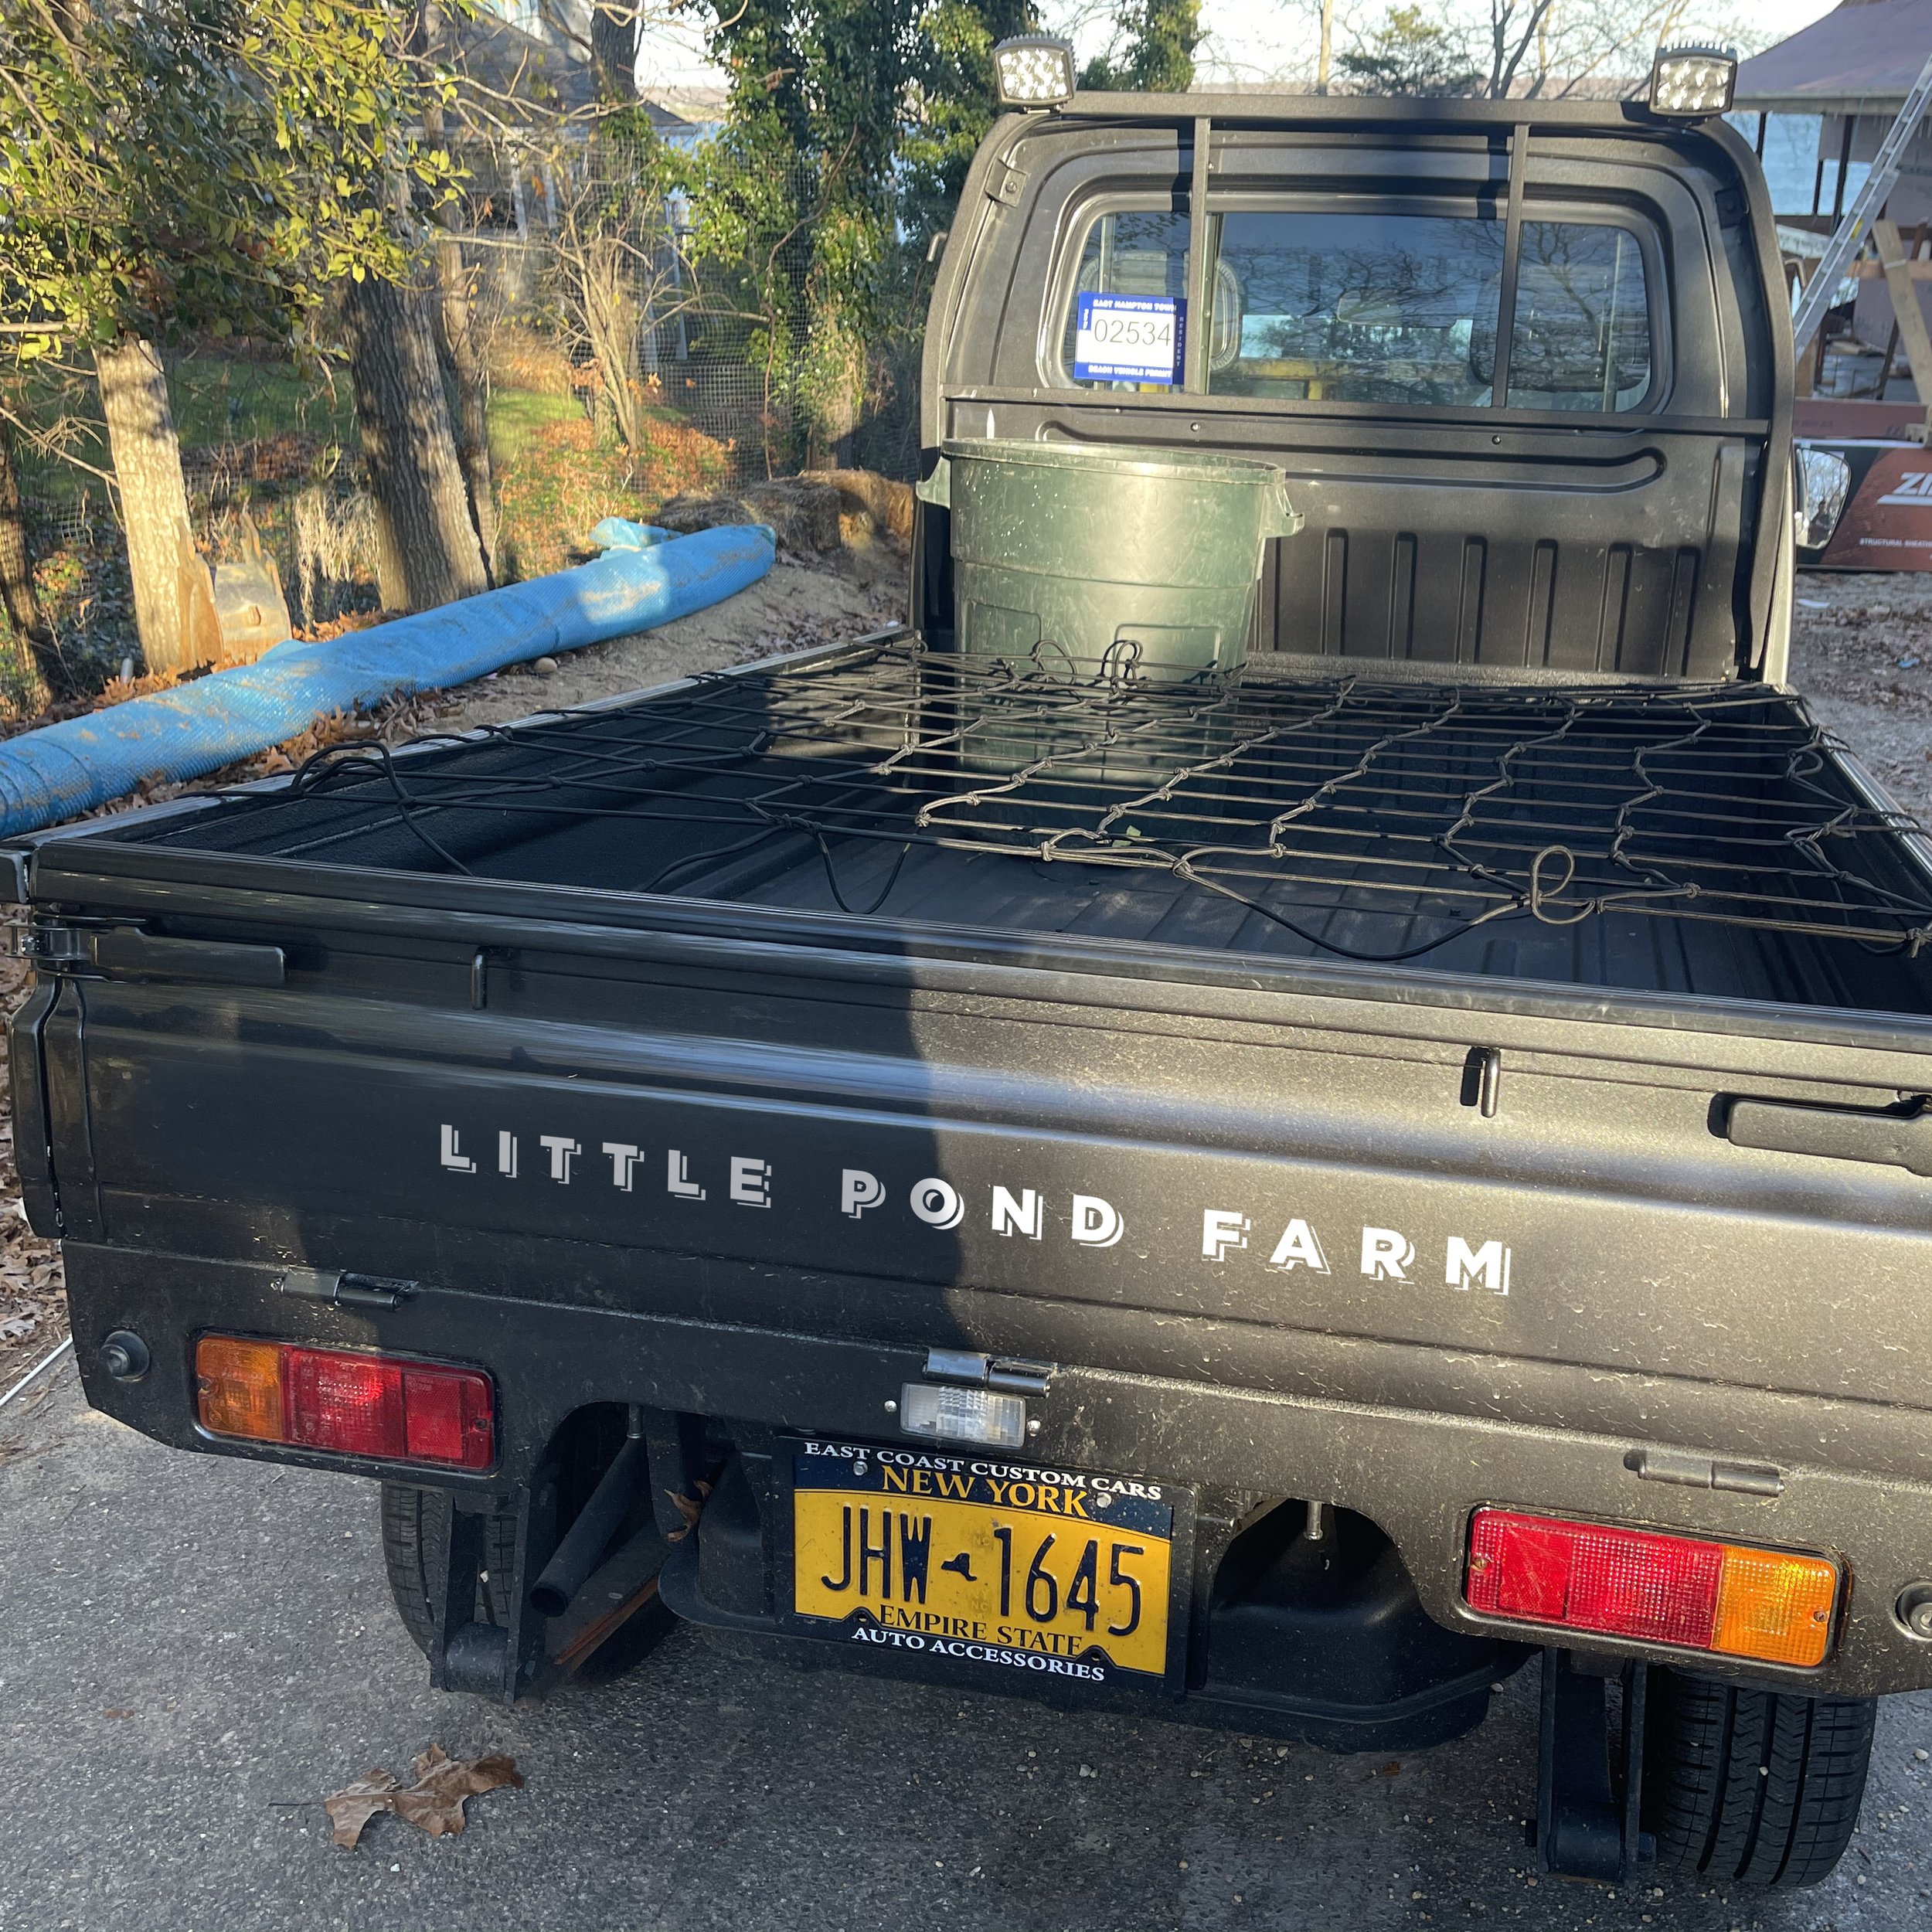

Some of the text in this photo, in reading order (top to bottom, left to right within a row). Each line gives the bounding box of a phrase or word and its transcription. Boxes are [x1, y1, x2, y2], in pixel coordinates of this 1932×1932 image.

[1093, 299, 1114, 308] EAST
[1114, 301, 1153, 311] HAMPTON
[1094, 318, 1172, 347] 02534
[1859, 538, 1903, 547] STRUCTURAL
[440, 1124, 1512, 1295] LITTLE POND FARM
[804, 1442, 1162, 1500] EAST COAST CUSTOM CARS
[882, 1465, 1089, 1518] NEW YORK
[851, 1627, 1106, 1682] AUTO ACCESSORIES
[880, 1604, 1082, 1657] EMPIRE STATE
